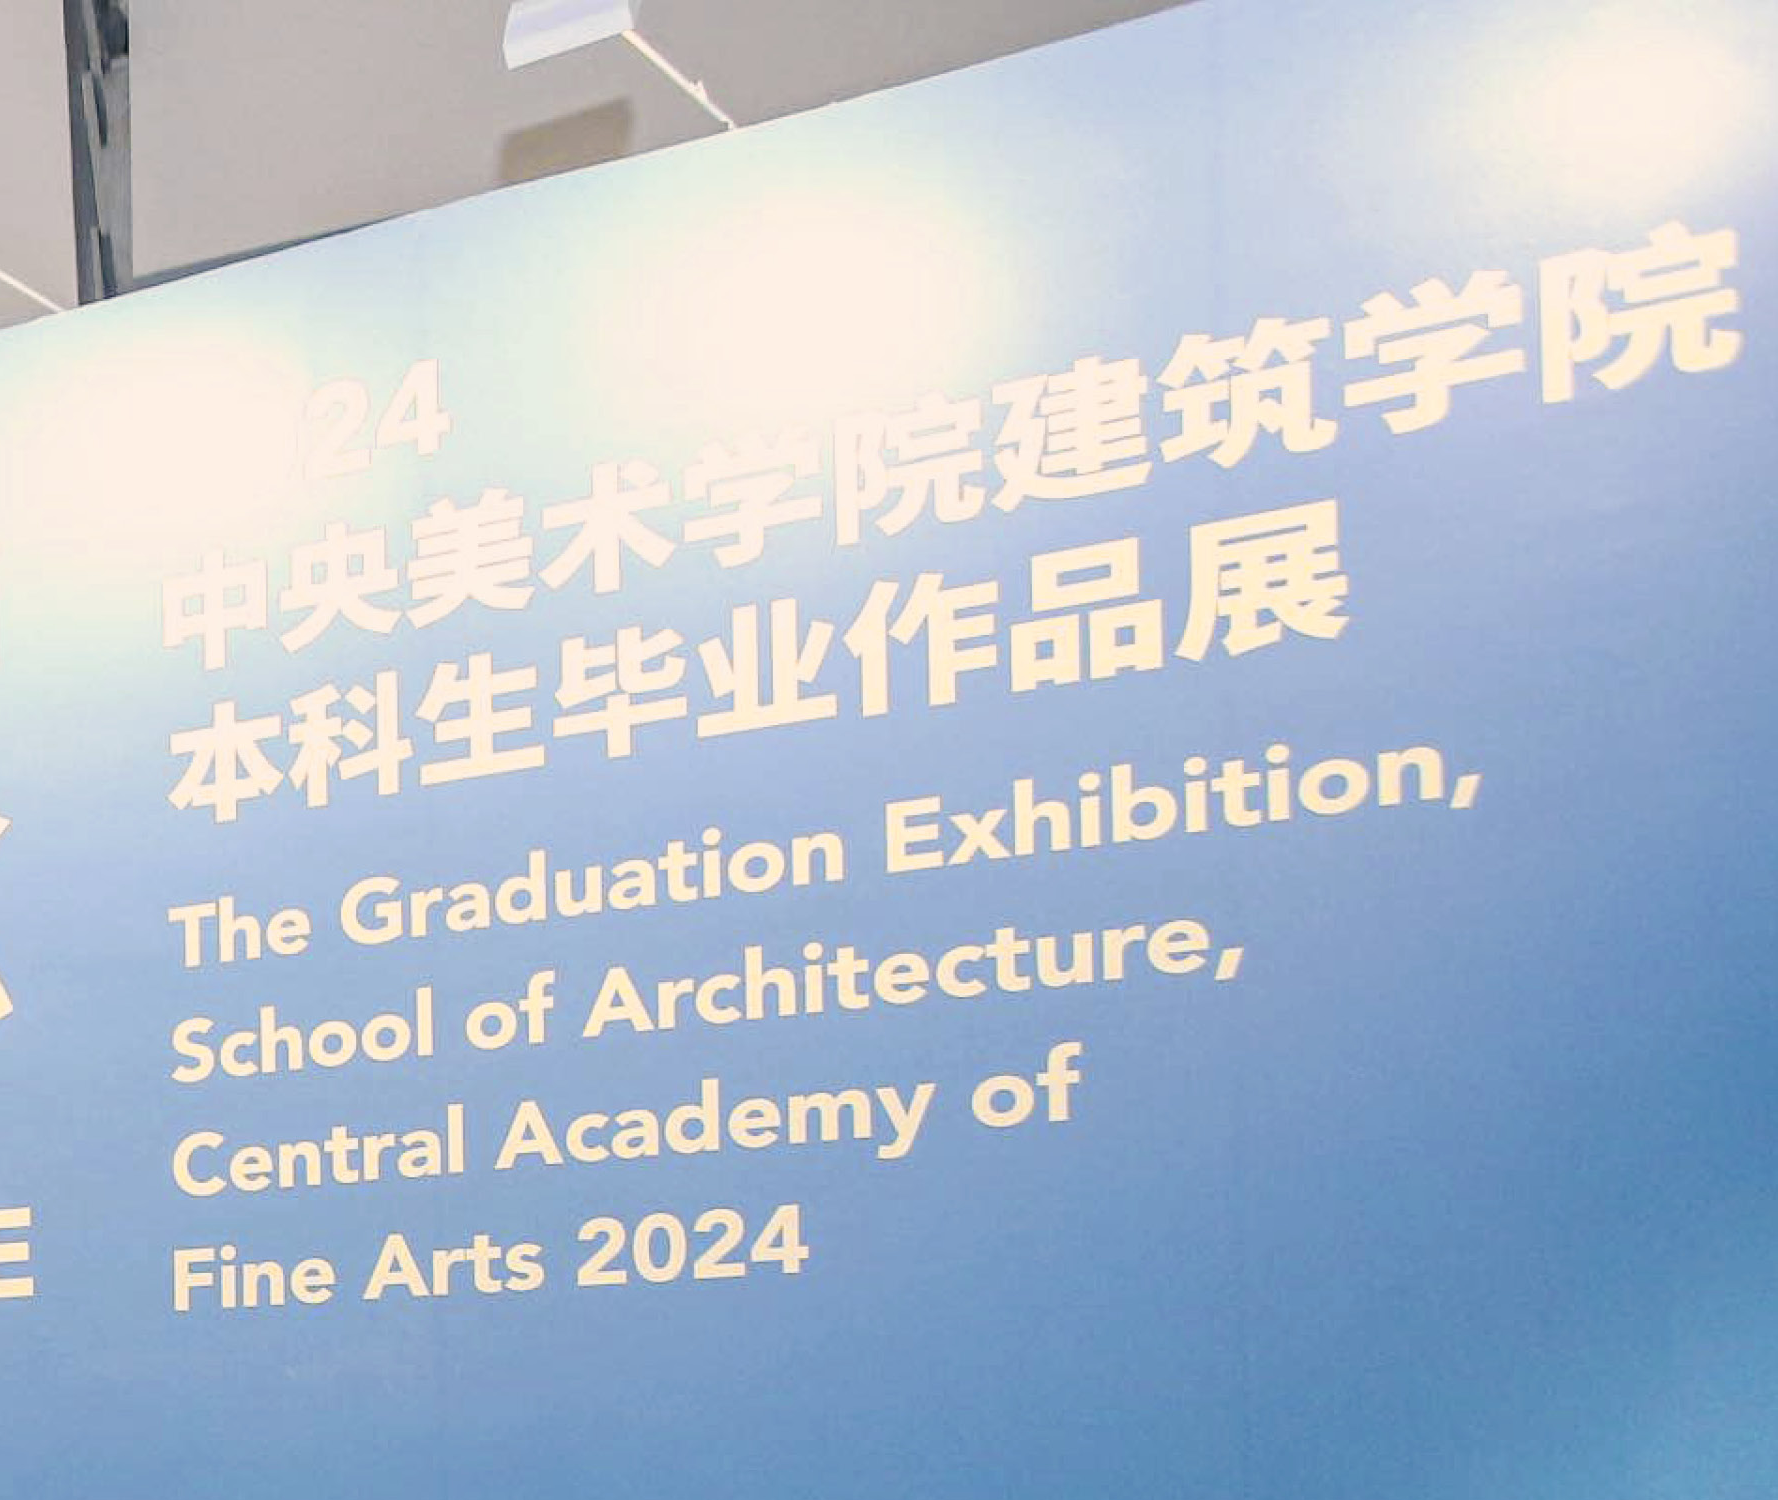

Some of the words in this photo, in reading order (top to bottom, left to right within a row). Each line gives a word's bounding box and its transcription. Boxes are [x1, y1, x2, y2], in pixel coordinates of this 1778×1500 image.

[159, 218, 1744, 673] 中央美术学院建筑学院
[165, 500, 1352, 827] 本科生毕业作品展
[167, 896, 313, 970] The
[338, 827, 847, 948] Graduation
[882, 740, 1483, 875] Exhibition,
[170, 985, 436, 1085] School
[463, 969, 556, 1052] of
[580, 916, 1247, 1040] Architecture,
[170, 1102, 468, 1199] Central
[493, 1077, 938, 1171] Academy
[971, 1040, 1085, 1128] of
[171, 1243, 338, 1313] Fine
[362, 1229, 546, 1301] Arts
[576, 1202, 811, 1287] 2024
